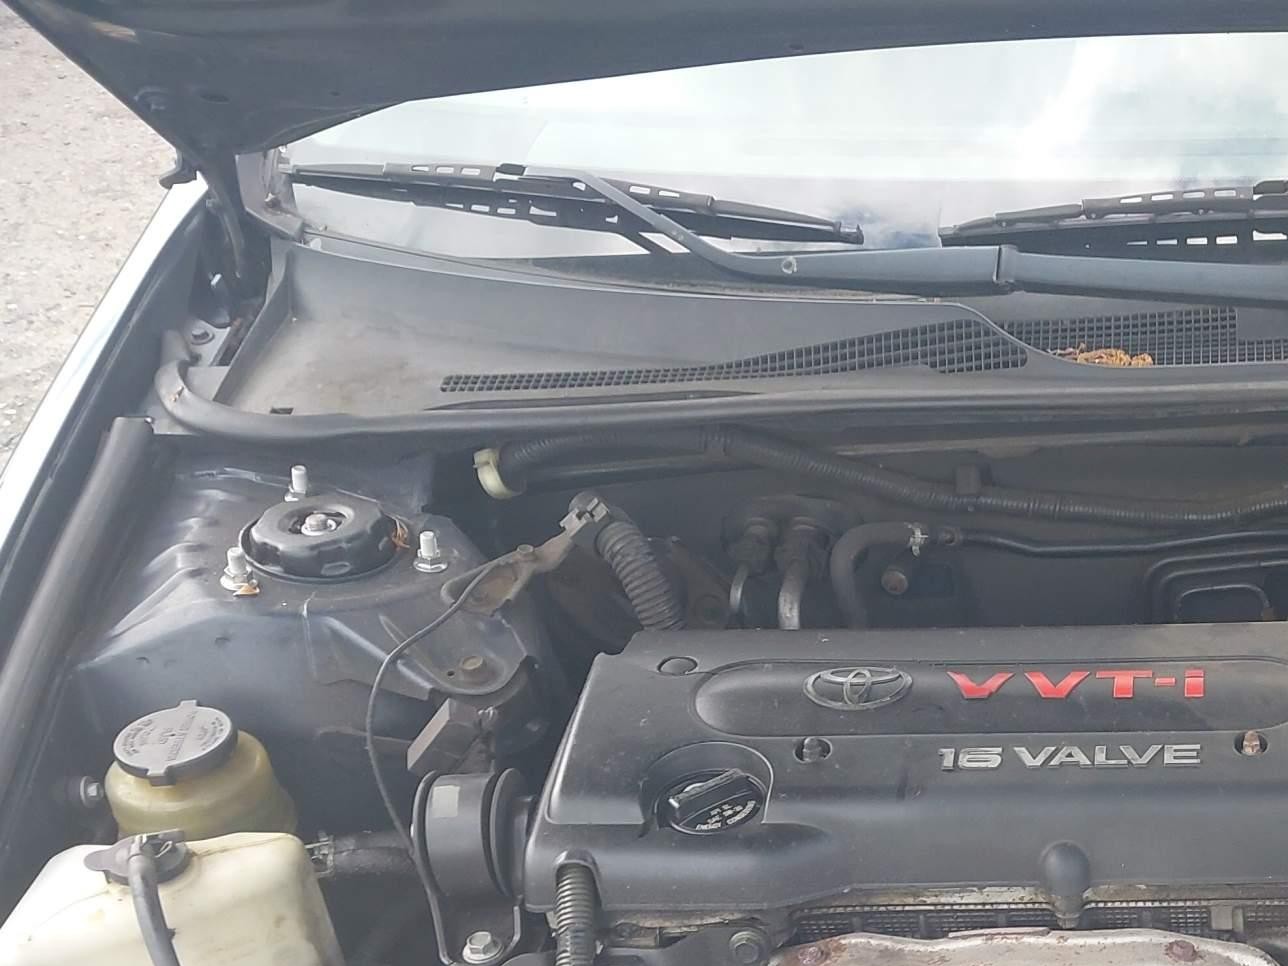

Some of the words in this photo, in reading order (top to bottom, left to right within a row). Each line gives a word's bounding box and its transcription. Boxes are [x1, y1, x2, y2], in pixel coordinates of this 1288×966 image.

[947, 671, 1204, 698] VVT-i
[939, 747, 1002, 770] 16
[1014, 744, 1201, 767] VALVE
